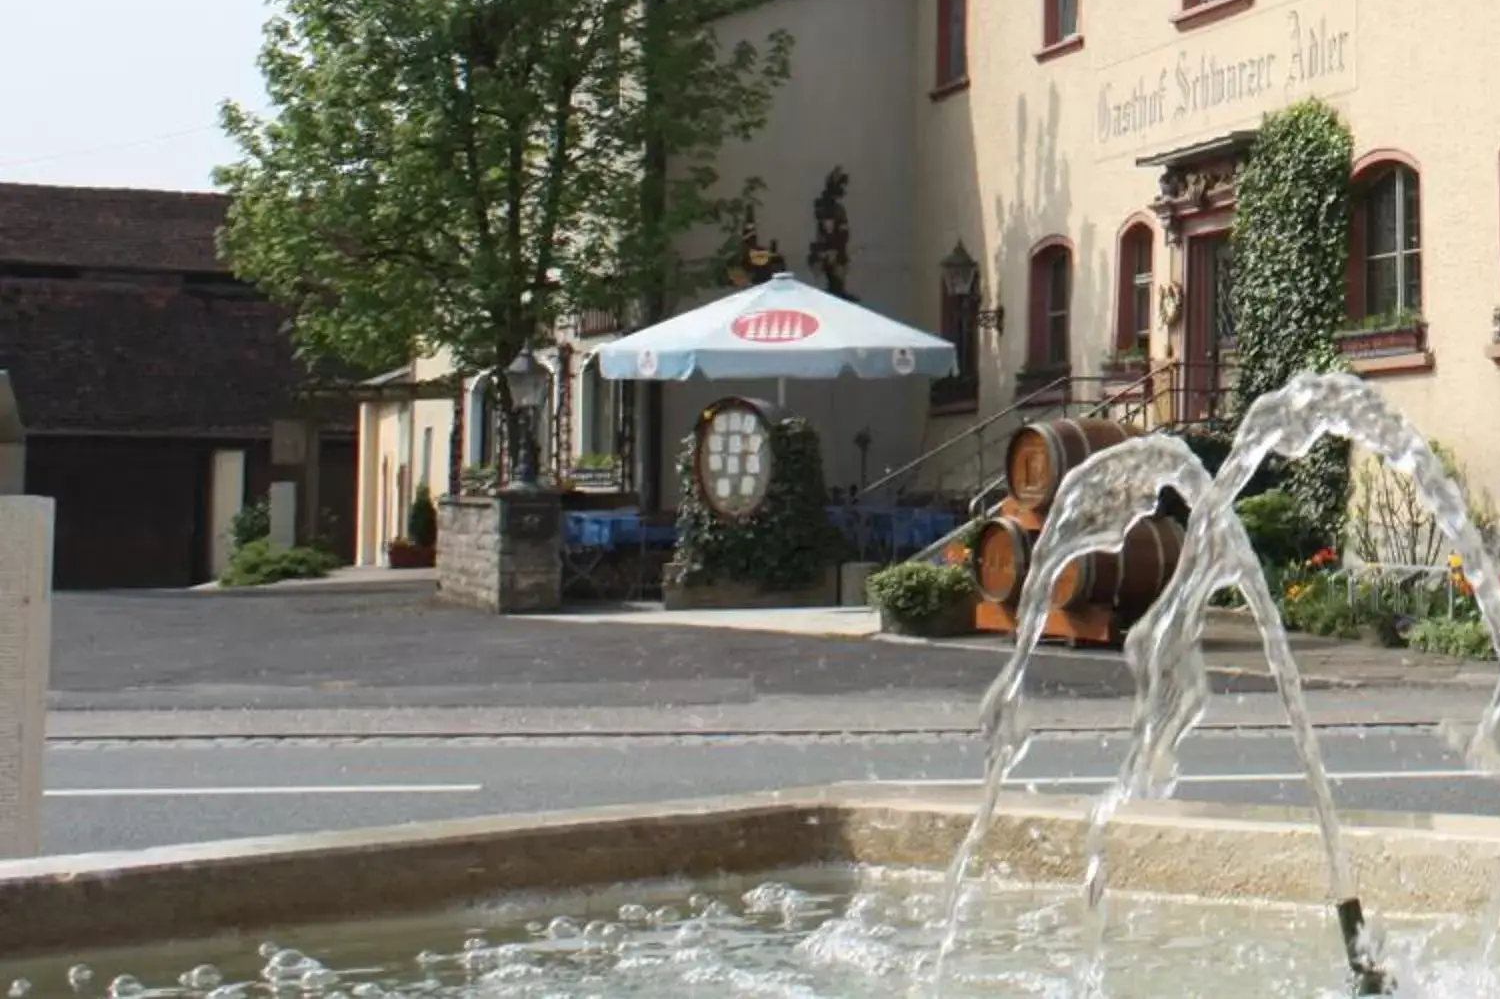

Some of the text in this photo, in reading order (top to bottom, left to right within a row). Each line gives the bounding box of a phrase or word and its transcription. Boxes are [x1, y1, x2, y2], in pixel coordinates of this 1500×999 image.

[1096, 10, 1349, 142] Gasthof Schwarzer Adler
